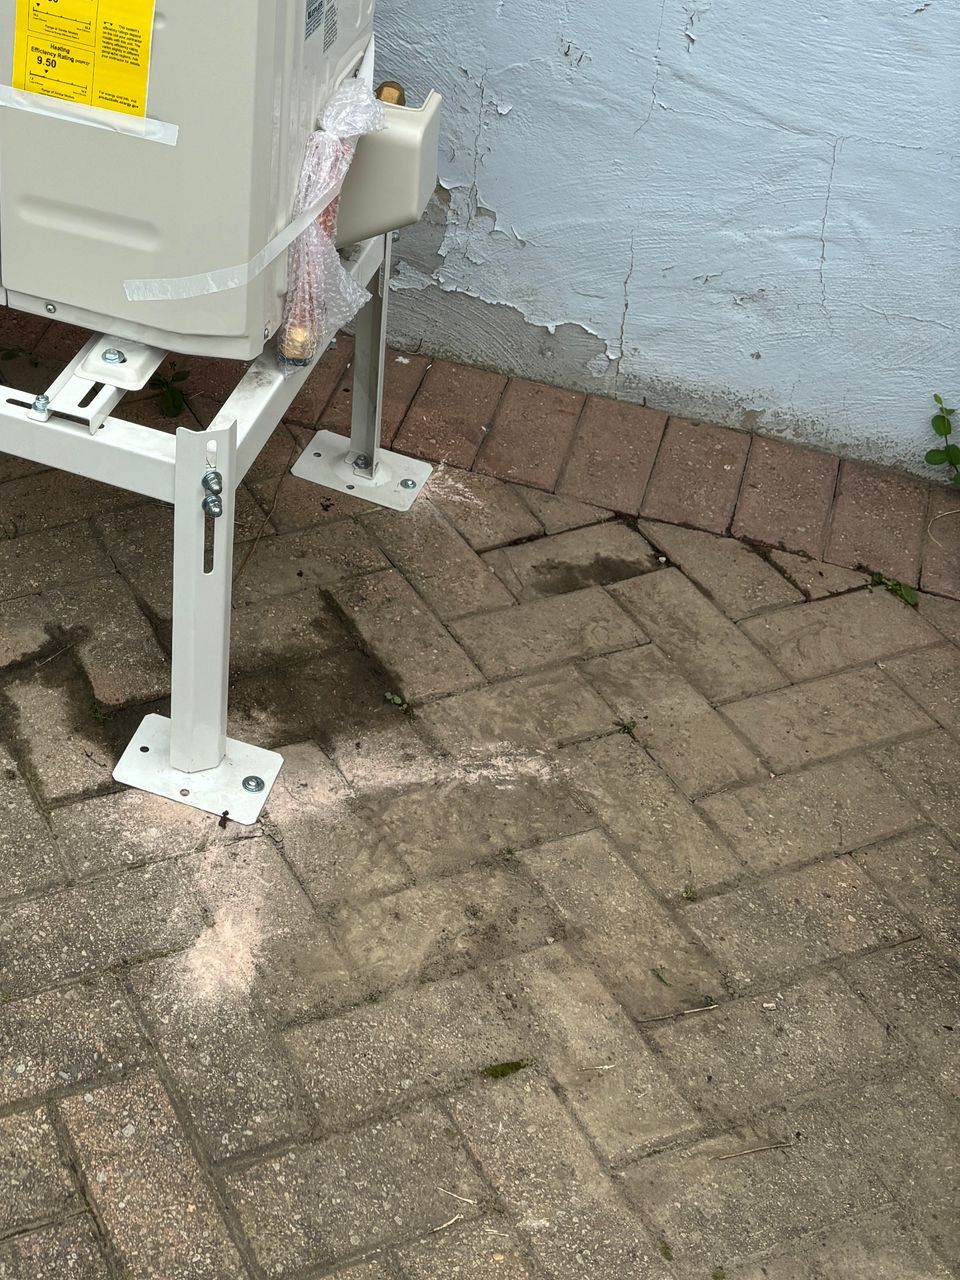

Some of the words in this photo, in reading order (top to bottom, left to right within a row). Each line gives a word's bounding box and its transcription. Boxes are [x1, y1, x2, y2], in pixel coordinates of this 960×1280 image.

[30, 45, 57, 59] Efficiency
[57, 51, 75, 63] Rating
[50, 43, 70, 55] Heating
[36, 55, 57, 69] 9.50
